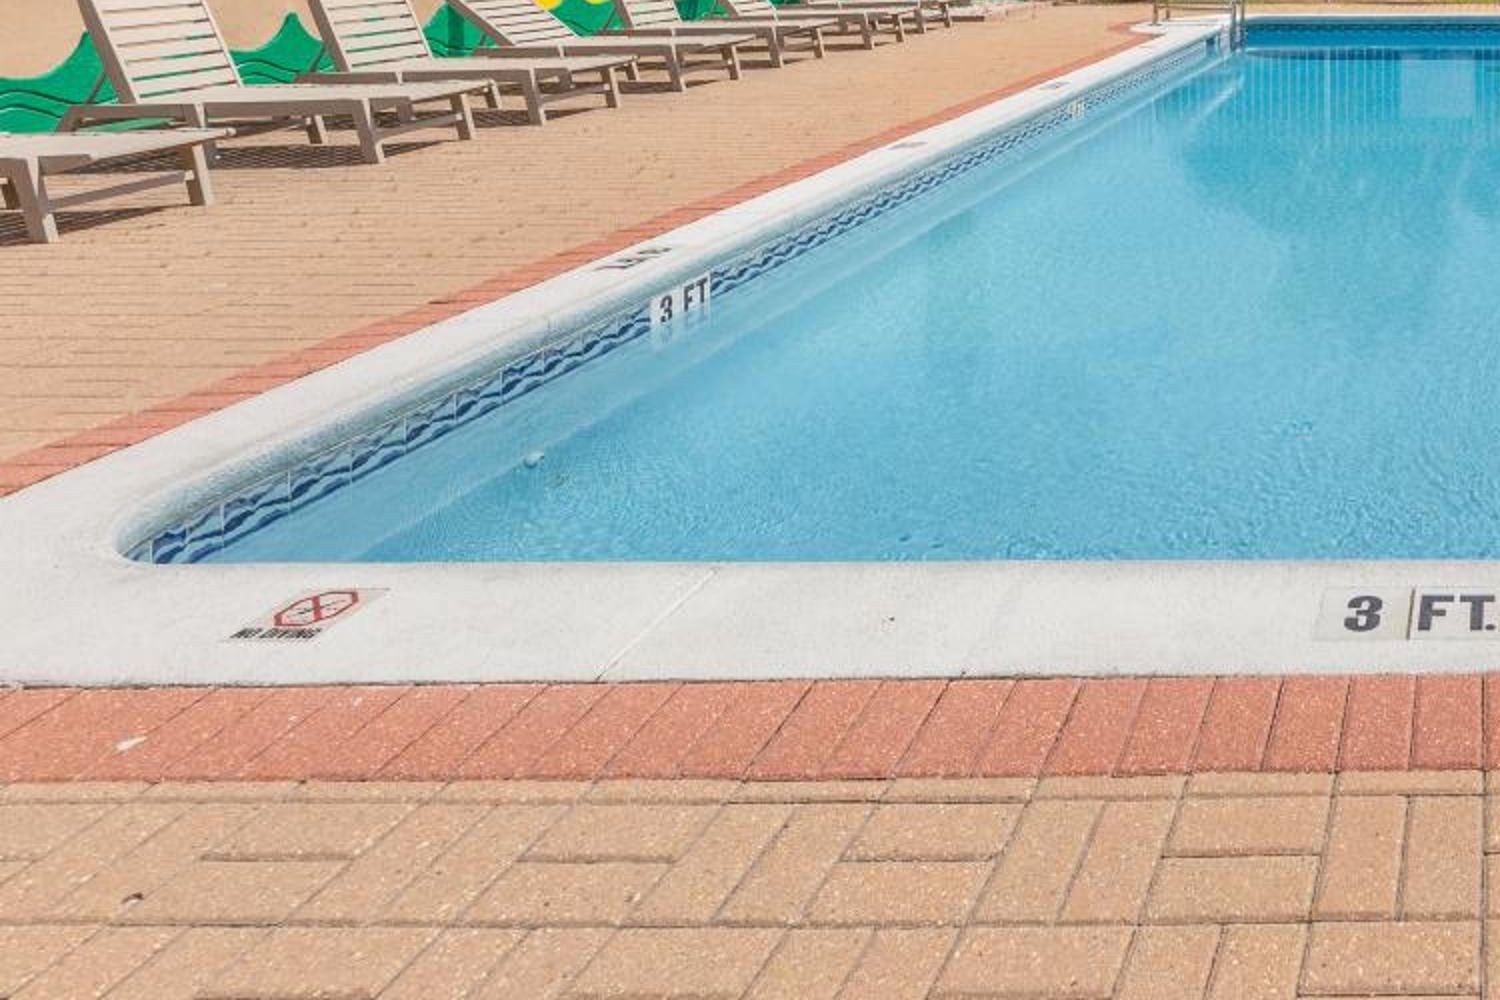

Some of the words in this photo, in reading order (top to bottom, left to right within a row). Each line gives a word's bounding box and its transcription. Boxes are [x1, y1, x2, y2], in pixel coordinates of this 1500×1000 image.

[659, 295, 673, 322] 3
[683, 277, 708, 312] FT
[1344, 595, 1383, 632] 3
[1417, 594, 1496, 632] FT.
